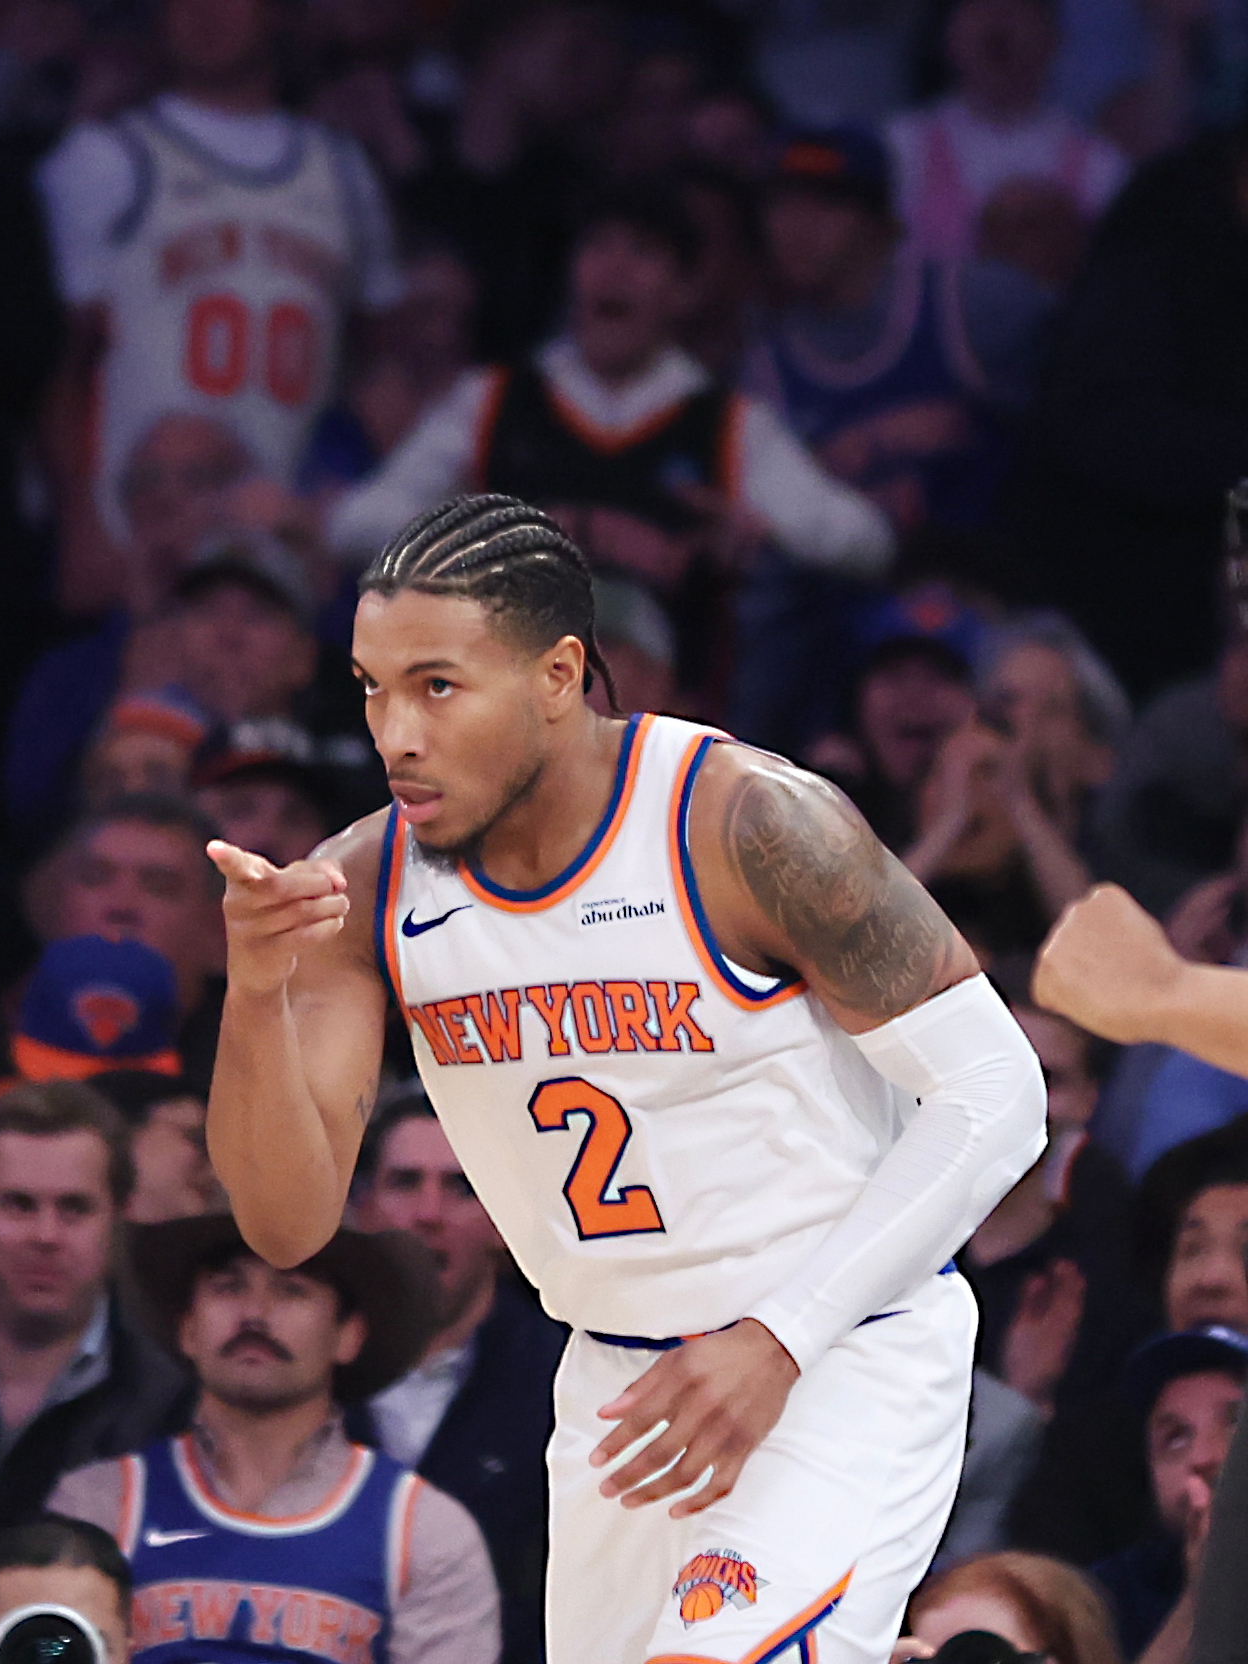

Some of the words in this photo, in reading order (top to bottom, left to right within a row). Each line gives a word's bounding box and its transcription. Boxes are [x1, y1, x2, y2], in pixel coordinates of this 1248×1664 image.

[581, 897, 626, 910] experience
[581, 910, 613, 926] abu
[616, 898, 665, 920] dhabi
[409, 988, 523, 1066] NEW
[526, 980, 715, 1057] YORK
[527, 1076, 667, 1241] 2
[673, 1553, 757, 1604] KNICKS
